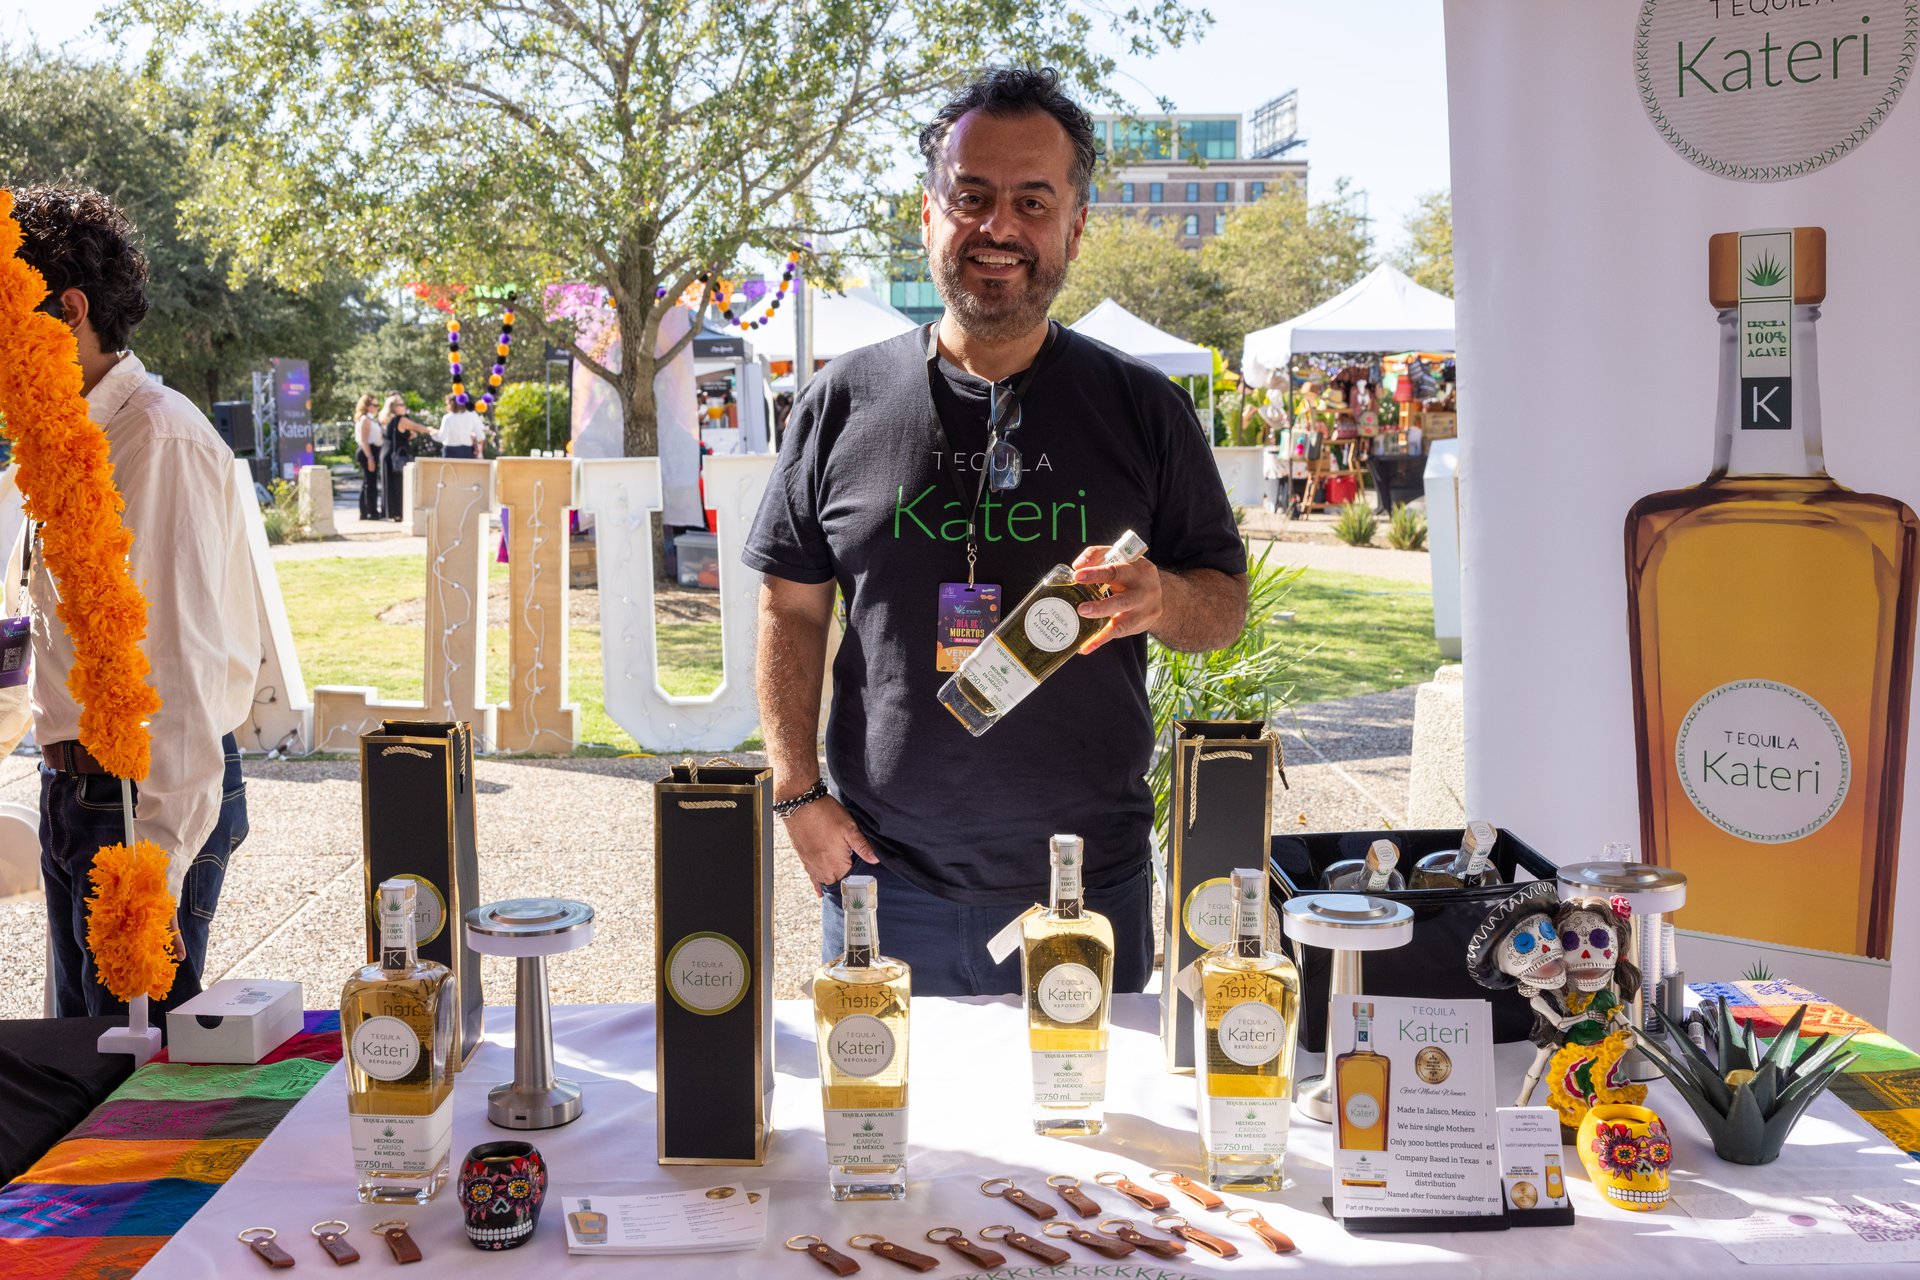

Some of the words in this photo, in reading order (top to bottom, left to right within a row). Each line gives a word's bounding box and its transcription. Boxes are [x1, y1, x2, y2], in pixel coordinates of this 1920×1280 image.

[1677, 15, 1871, 98] Kateri
[1752, 386, 1781, 423] K
[894, 484, 1087, 543] Kateri
[1035, 608, 1069, 642] Kateri
[949, 627, 985, 639] MUERTOS
[1724, 731, 1799, 750] TEQUILA
[1703, 750, 1820, 794] Kateri
[1198, 912, 1231, 926] Kate
[682, 970, 732, 987] Kateri
[1048, 987, 1092, 1001] Kateri
[1412, 1006, 1456, 1016] TEQUILA
[371, 1033, 400, 1041] TEQUILA
[846, 1031, 876, 1039] TEQUILA
[1228, 1027, 1276, 1042] Kateri
[1399, 1019, 1468, 1044] Kateri
[362, 1041, 409, 1058] Kateri
[836, 1040, 885, 1055] Kateri
[1043, 1092, 1059, 1100] 750
[1400, 1086, 1417, 1095] Gold
[1417, 1087, 1440, 1097] Medal
[1440, 1088, 1467, 1097] Winner
[1350, 1109, 1375, 1118] Kateri
[1397, 1106, 1416, 1114] Made
[1451, 1109, 1476, 1117] Mexico
[1398, 1122, 1408, 1130] We
[1410, 1122, 1423, 1130] hire
[1424, 1123, 1445, 1132] single
[1446, 1125, 1475, 1133] Mothers
[1223, 1143, 1240, 1151] 750
[1390, 1139, 1406, 1148] Only
[1425, 1139, 1449, 1148] bottles
[1450, 1141, 1482, 1151] produced
[363, 1160, 380, 1169] 750
[842, 1155, 859, 1163] 750
[1395, 1154, 1428, 1163] Company
[1429, 1155, 1449, 1163] Based
[1460, 1157, 1480, 1165] Texas
[1406, 1170, 1432, 1178] Limited
[1433, 1171, 1465, 1180] exclusive
[1415, 1179, 1456, 1188] distribution
[1410, 1191, 1425, 1200] after
[1425, 1193, 1455, 1201] Founder's
[1456, 1194, 1484, 1203] daughter
[1345, 1203, 1357, 1211] Part
[1374, 1205, 1400, 1213] proceeds
[1411, 1206, 1434, 1214] donated
